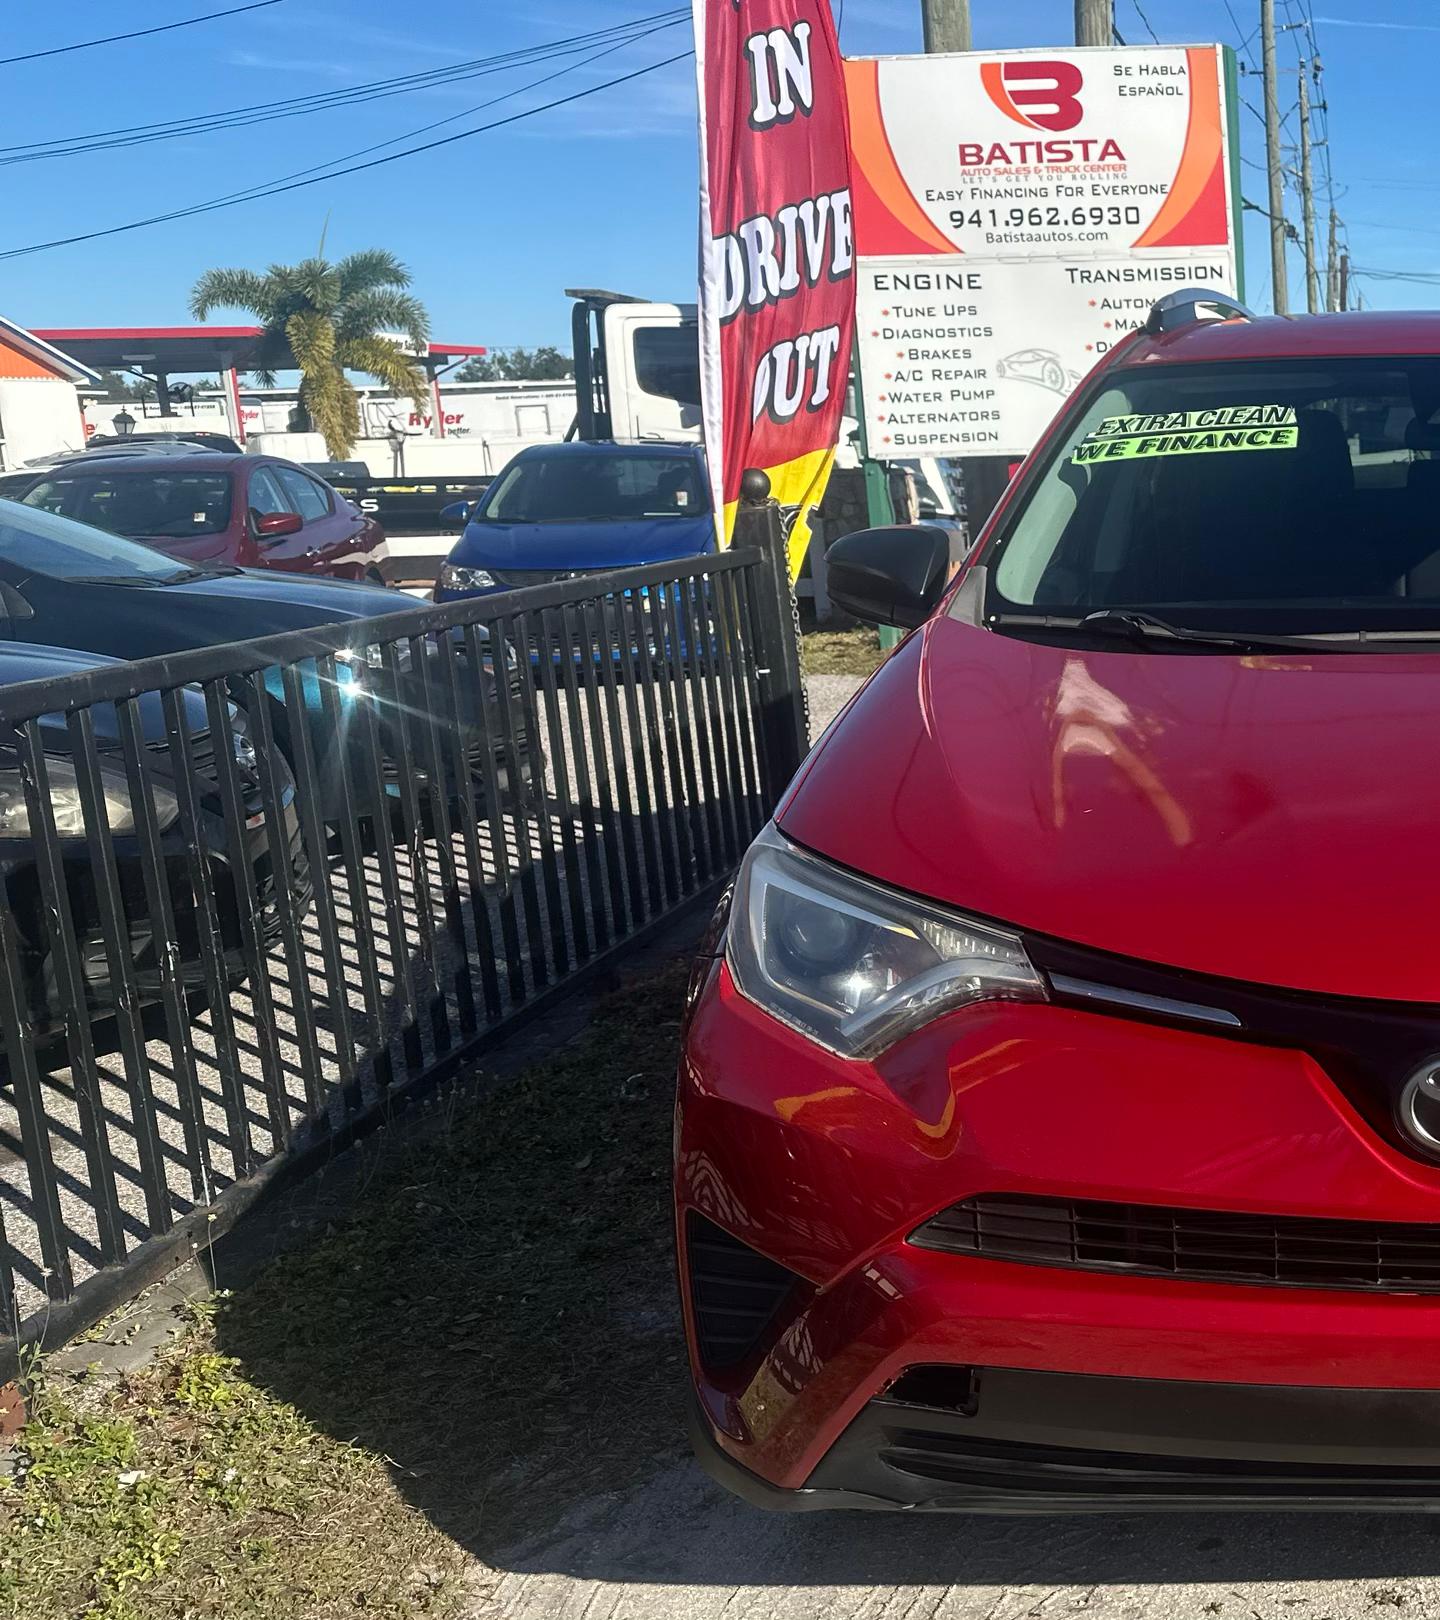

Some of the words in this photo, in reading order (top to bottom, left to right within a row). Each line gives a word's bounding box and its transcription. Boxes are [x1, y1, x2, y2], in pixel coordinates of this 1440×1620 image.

[748, 22, 813, 124] IN
[1113, 65, 1133, 76] SE
[1139, 64, 1187, 76] HABLA
[1118, 83, 1184, 96] ESPAÑOL
[958, 139, 1127, 167] BATISTA
[960, 168, 992, 177] AUTO
[993, 166, 1032, 176] SALES
[1033, 166, 1042, 175] &
[1044, 165, 1081, 174] TRUCK
[1083, 163, 1128, 173] CENTER
[962, 176, 999, 184] LET'S
[1006, 175, 1030, 183] GET
[1038, 174, 1063, 182] YOU
[925, 189, 964, 202] EASY
[971, 186, 1049, 200] FINANCING
[1056, 184, 1085, 197] FOR
[1092, 183, 1169, 197] EVERYONE
[949, 206, 1141, 229] 941.962.6930
[985, 230, 1109, 244] Batistaautos.com
[711, 187, 853, 322] DRIVE
[1065, 265, 1224, 284] TRANSMISSION
[873, 273, 982, 291] ENGINE
[1100, 297, 1157, 310] AUTOM
[892, 306, 937, 318] TUNE
[943, 304, 978, 316] UPS
[882, 326, 993, 340] DIAGNOSTICS
[908, 348, 972, 361] BRAKES
[894, 369, 924, 383] A/C
[931, 369, 988, 381] REPAIR
[887, 391, 943, 403] WATER
[950, 389, 996, 401] PUMP
[887, 410, 1001, 424] ALTERNATORS
[1095, 412, 1191, 435] EXTRA
[1195, 405, 1294, 427] CLEAN
[894, 431, 999, 445] SUSPENSION
[1075, 441, 1130, 462] WE
[1135, 429, 1294, 455] FINANCE
